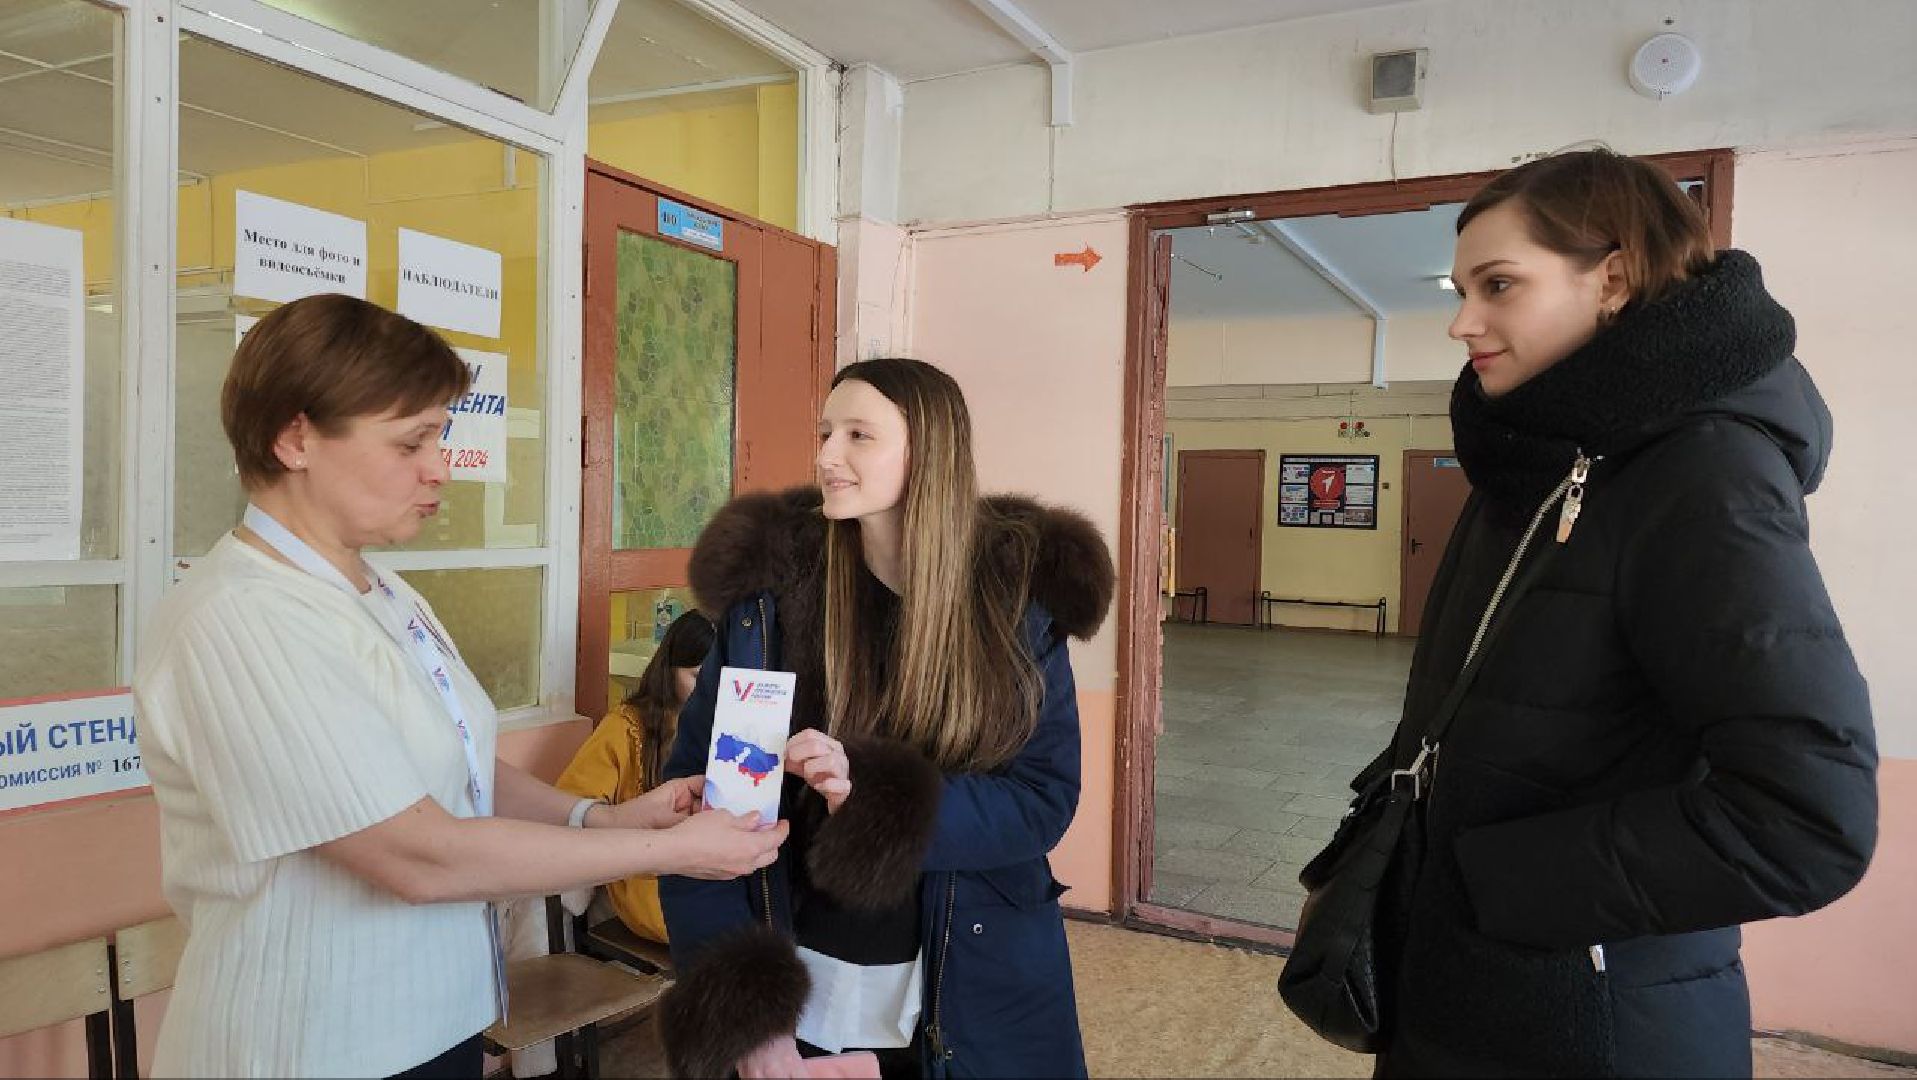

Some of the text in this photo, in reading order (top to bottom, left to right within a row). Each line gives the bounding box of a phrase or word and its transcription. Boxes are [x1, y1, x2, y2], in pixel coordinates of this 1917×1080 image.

[243, 228, 288, 249] Место
[318, 246, 349, 263] фото
[352, 255, 360, 267] и
[402, 268, 498, 300] НАБЛЮДАТЕЛИ
[454, 449, 489, 469] 2024
[86, 759, 102, 775] №
